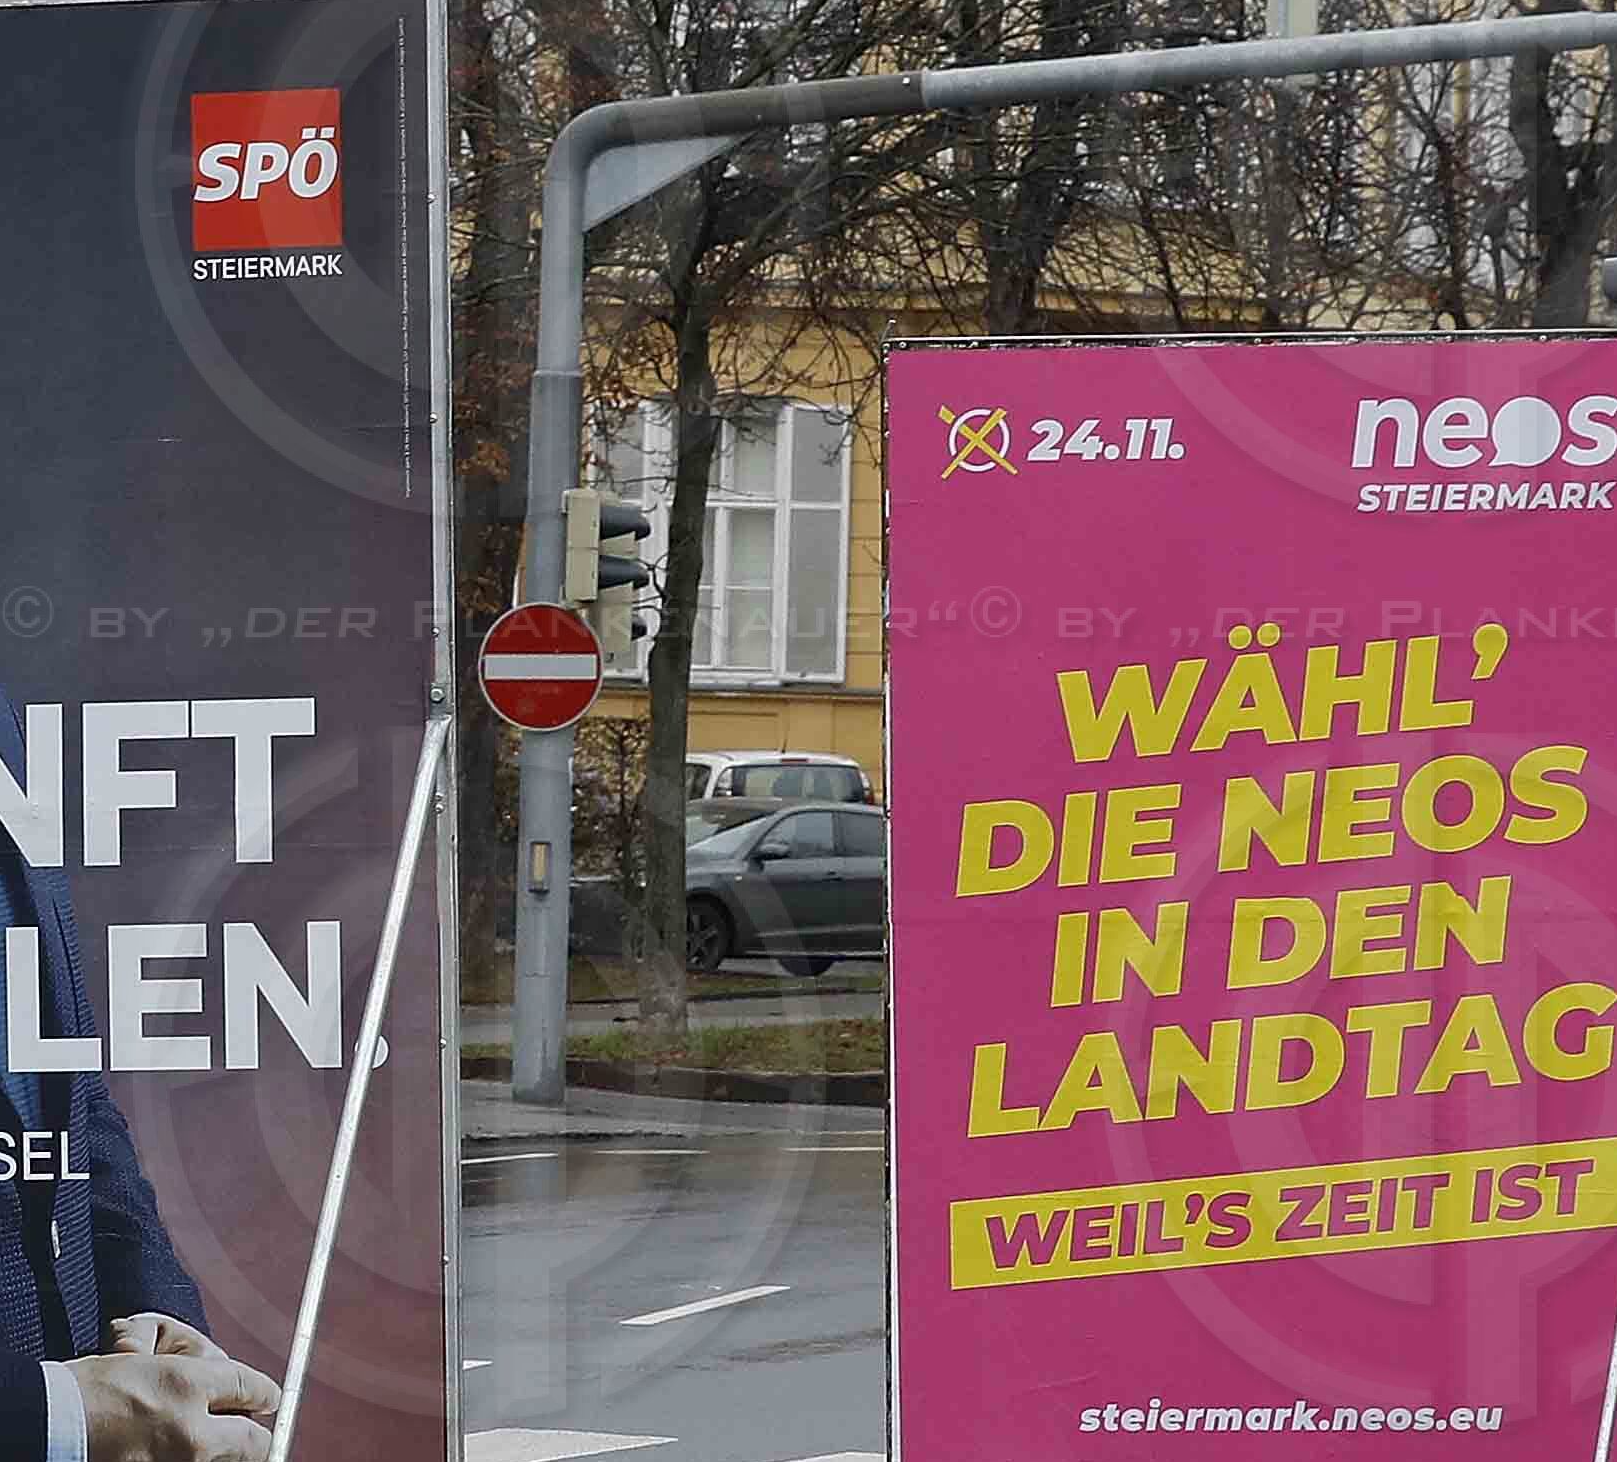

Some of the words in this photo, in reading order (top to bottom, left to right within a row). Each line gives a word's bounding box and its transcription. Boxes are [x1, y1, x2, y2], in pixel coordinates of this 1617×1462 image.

[193, 126, 339, 203] SPÖ
[193, 253, 344, 281] STEIERMARK
[1025, 417, 1187, 463] 24.11.
[1356, 479, 1617, 514] STEIERMARK
[955, 782, 1183, 899] DIE
[1216, 743, 1590, 875] NEOS
[1049, 899, 1190, 1010] IN
[1224, 874, 1513, 991] DEN
[984, 1189, 1255, 1271] WEIL’S
[1273, 1171, 1452, 1244] ZEIT
[1469, 1158, 1596, 1224] IST
[1077, 1397, 1505, 1434] steiermark.neos.eu
